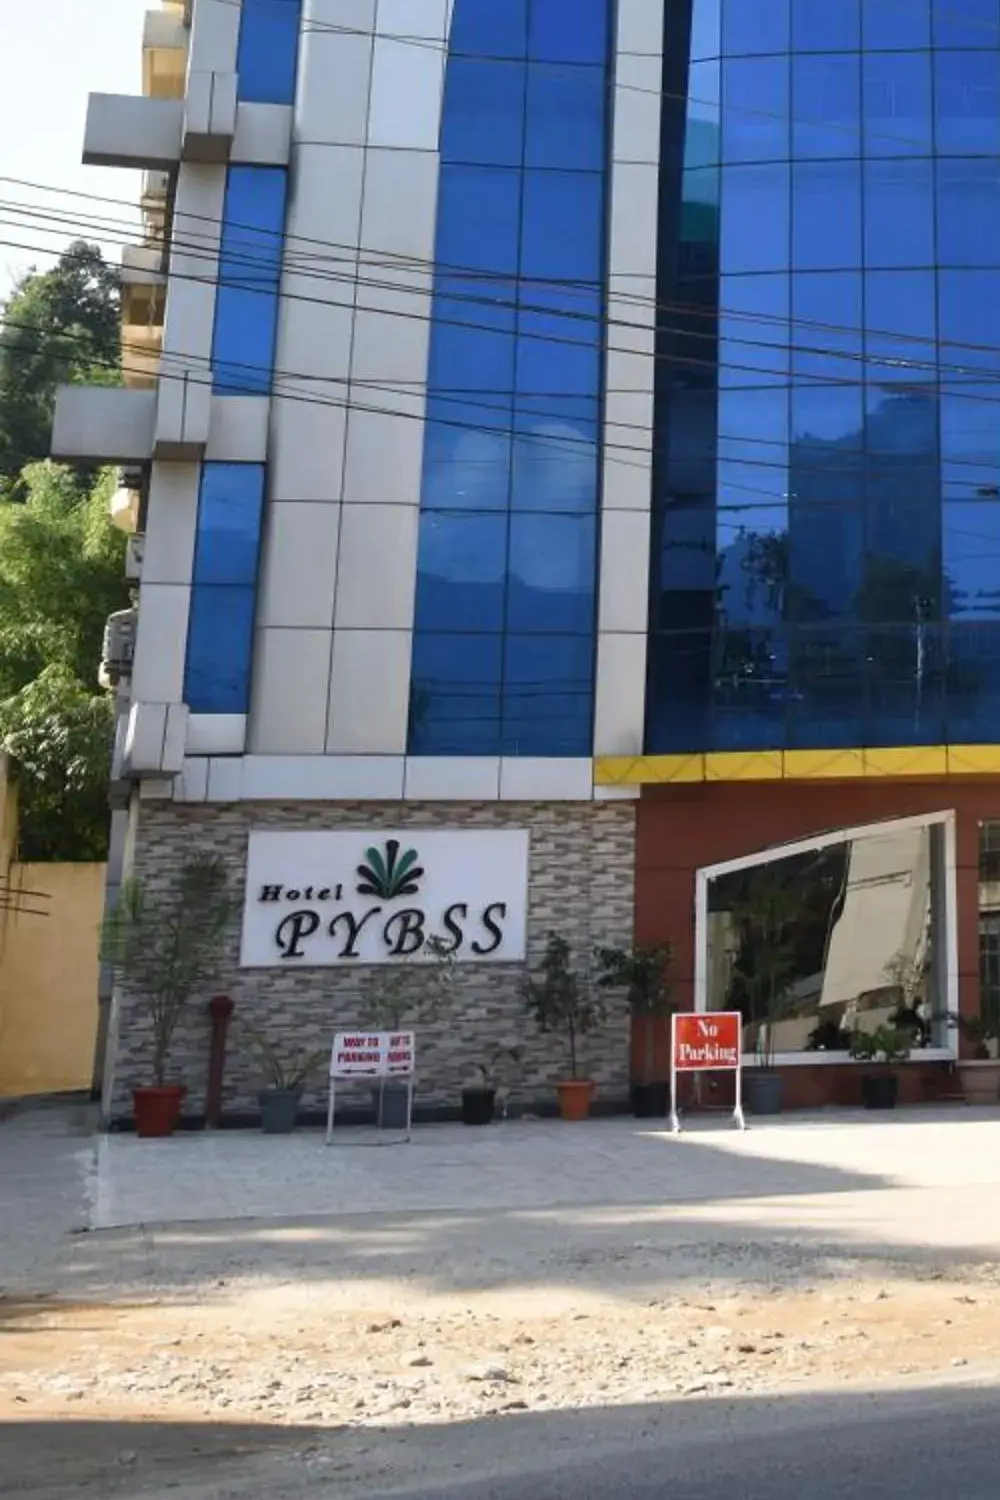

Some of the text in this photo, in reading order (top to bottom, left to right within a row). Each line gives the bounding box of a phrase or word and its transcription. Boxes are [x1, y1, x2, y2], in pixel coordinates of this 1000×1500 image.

[258, 883, 343, 902] Hotel
[275, 902, 507, 958] PYBSS
[697, 1019, 718, 1037] No
[343, 1036, 366, 1047] WAY
[338, 1051, 380, 1063] PARKING
[679, 1043, 737, 1062] Parking
